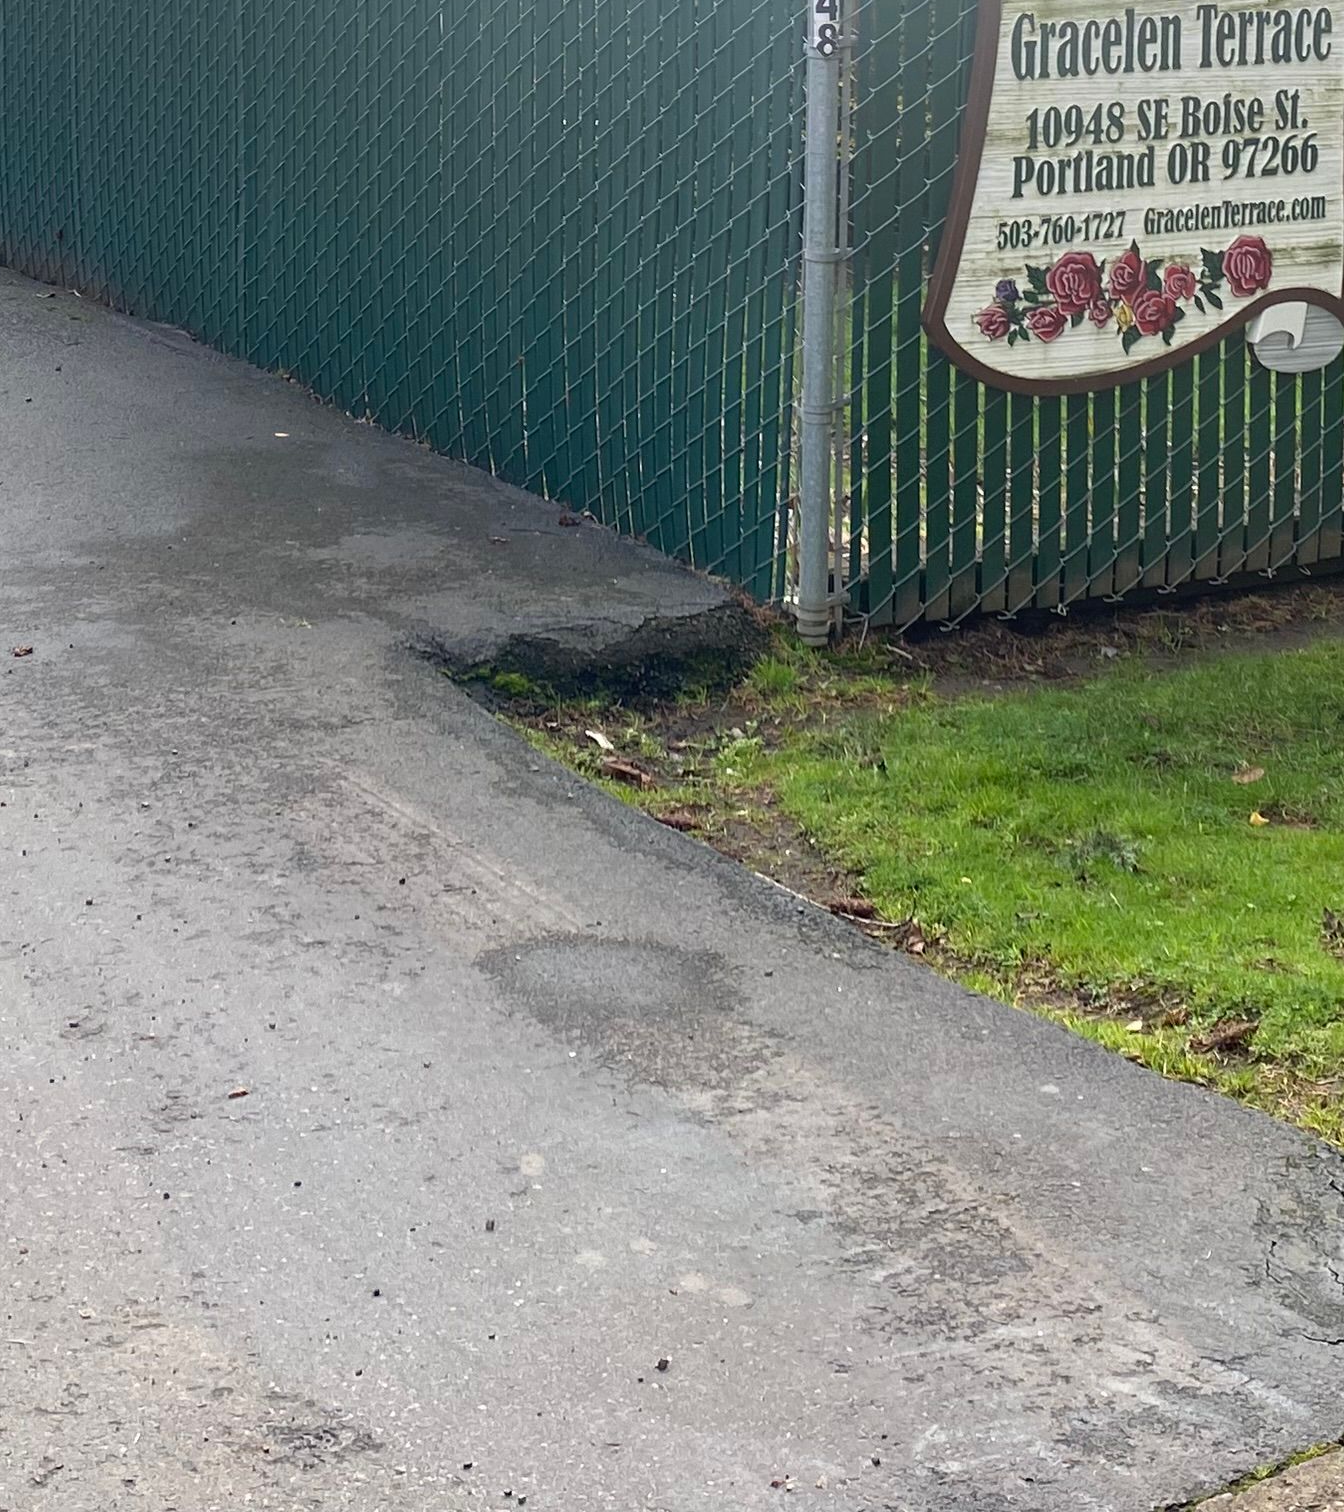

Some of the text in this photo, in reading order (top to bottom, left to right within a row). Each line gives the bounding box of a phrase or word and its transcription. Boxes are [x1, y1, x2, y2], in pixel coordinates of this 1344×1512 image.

[1011, 4, 1332, 81] Gracelen Terrace
[1026, 89, 1308, 150] 10948 SE Boise St.
[1011, 133, 1318, 199] Portland OR 97266
[996, 196, 1326, 251] 503-760-1727 GracelenTerrace.com
